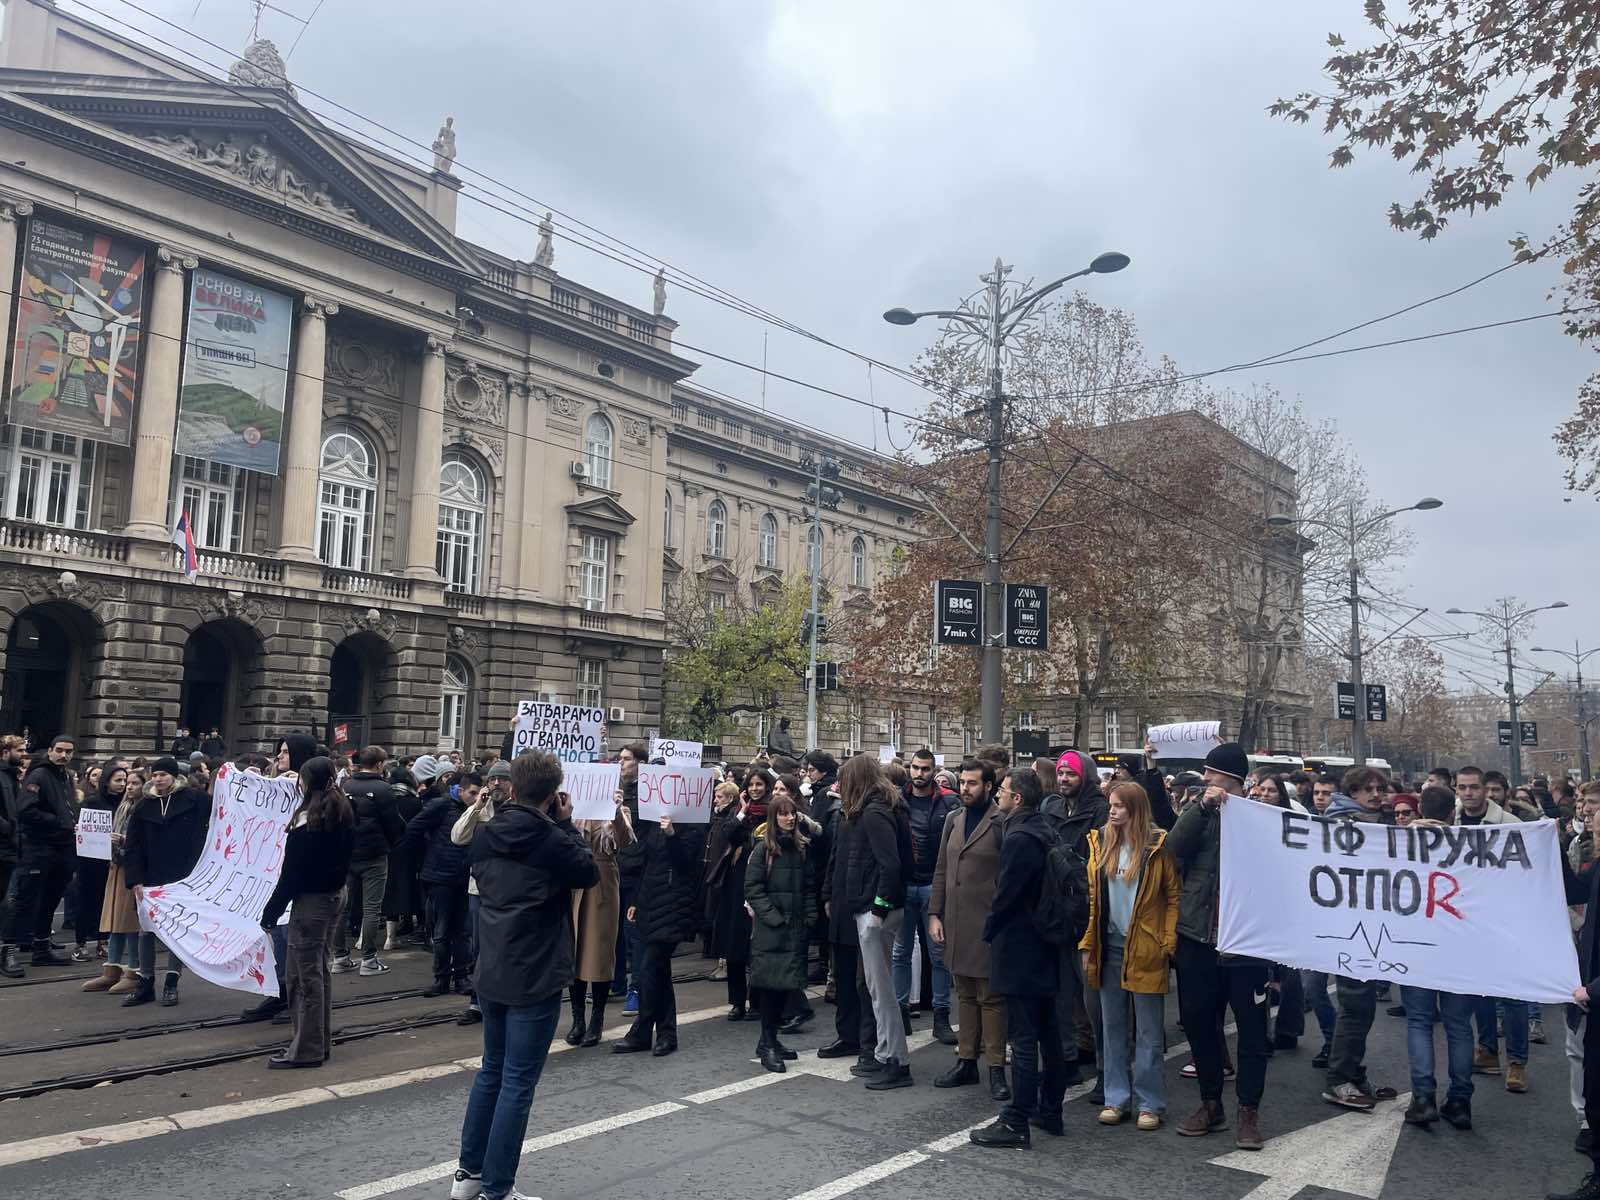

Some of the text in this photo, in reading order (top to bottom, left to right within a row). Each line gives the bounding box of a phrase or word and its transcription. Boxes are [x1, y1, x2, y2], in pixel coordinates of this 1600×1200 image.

[32, 235, 41, 244] 75
[42, 239, 69, 252] година
[70, 247, 81, 256] од
[246, 290, 263, 305] ЗА
[949, 597, 973, 610] BIG
[1022, 613, 1034, 621] BIG
[1018, 635, 1038, 645] CCC
[521, 702, 603, 723] ЗАТВАРАМО
[532, 717, 581, 734] ВРАТА
[517, 729, 596, 751] ОТВАРАМО
[229, 772, 248, 803] НЕ
[639, 772, 713, 808] ЗАСТАНИ
[1281, 810, 1533, 870] ЕТФ ПРУЖА
